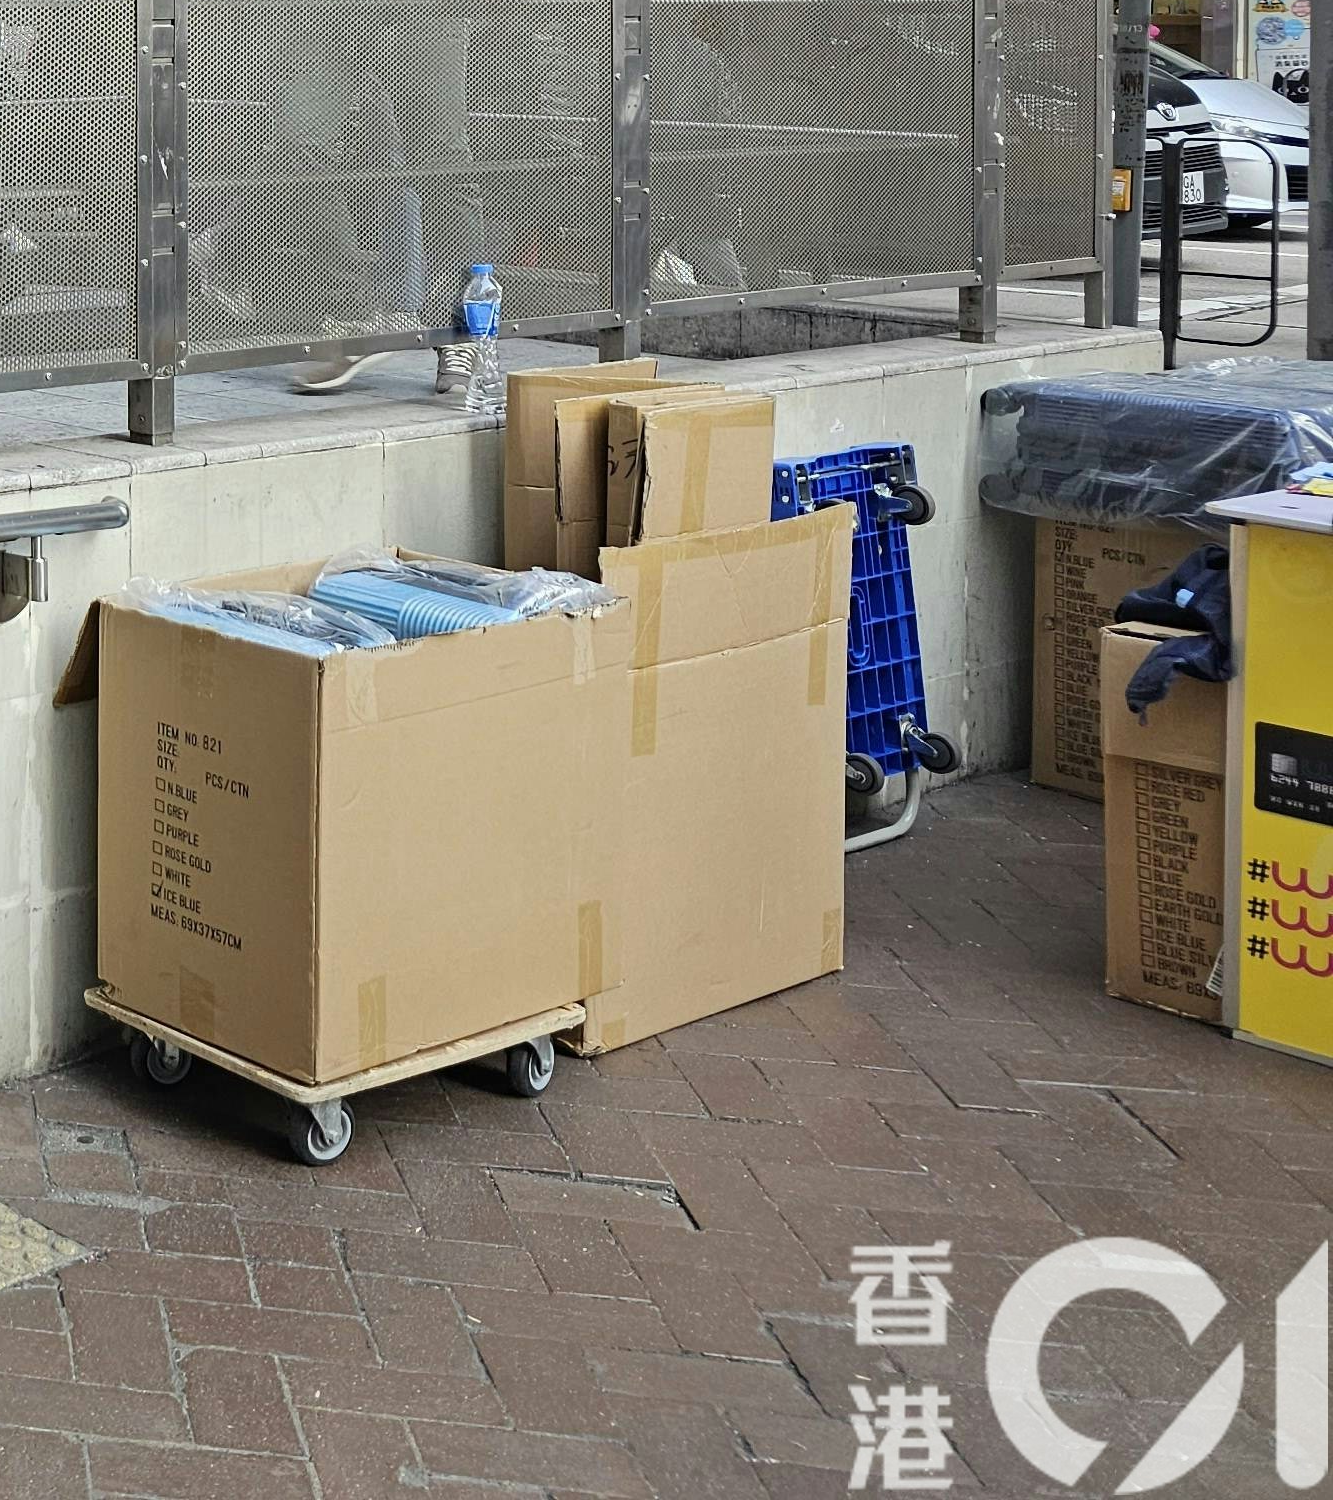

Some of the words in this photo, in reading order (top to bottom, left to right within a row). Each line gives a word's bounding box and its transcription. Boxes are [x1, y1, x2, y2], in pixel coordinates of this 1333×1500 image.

[1096, 606, 1113, 619] GRE
[157, 721, 179, 741] ITEM
[203, 734, 221, 755] 821
[205, 771, 249, 799] PCS/CTN
[167, 803, 189, 823] GREY
[1152, 796, 1181, 812] GREY
[1153, 810, 1189, 828] GREEN
[166, 823, 199, 848] PURPLE
[1153, 825, 1198, 846] YELLOW
[165, 845, 186, 865] ROSE
[189, 854, 211, 874] GOLD
[1153, 840, 1198, 860] PURPLE
[1153, 854, 1189, 873] BLACK
[165, 866, 191, 888] WHITE
[1154, 869, 1184, 888] BLUE
[163, 888, 177, 905] ICE
[179, 895, 201, 915] BLUE
[1155, 883, 1184, 901] ROSE
[1186, 891, 1216, 909] GOLD
[1155, 899, 1191, 918] EARTH
[181, 915, 242, 951] 69X37X57CM
[1156, 914, 1190, 932] WHITE
[1156, 928, 1173, 942] ICE
[1177, 932, 1206, 951] BLUE
[1157, 942, 1186, 962] BLUE
[1189, 950, 1217, 968] SILV
[1158, 958, 1196, 978] BROWN
